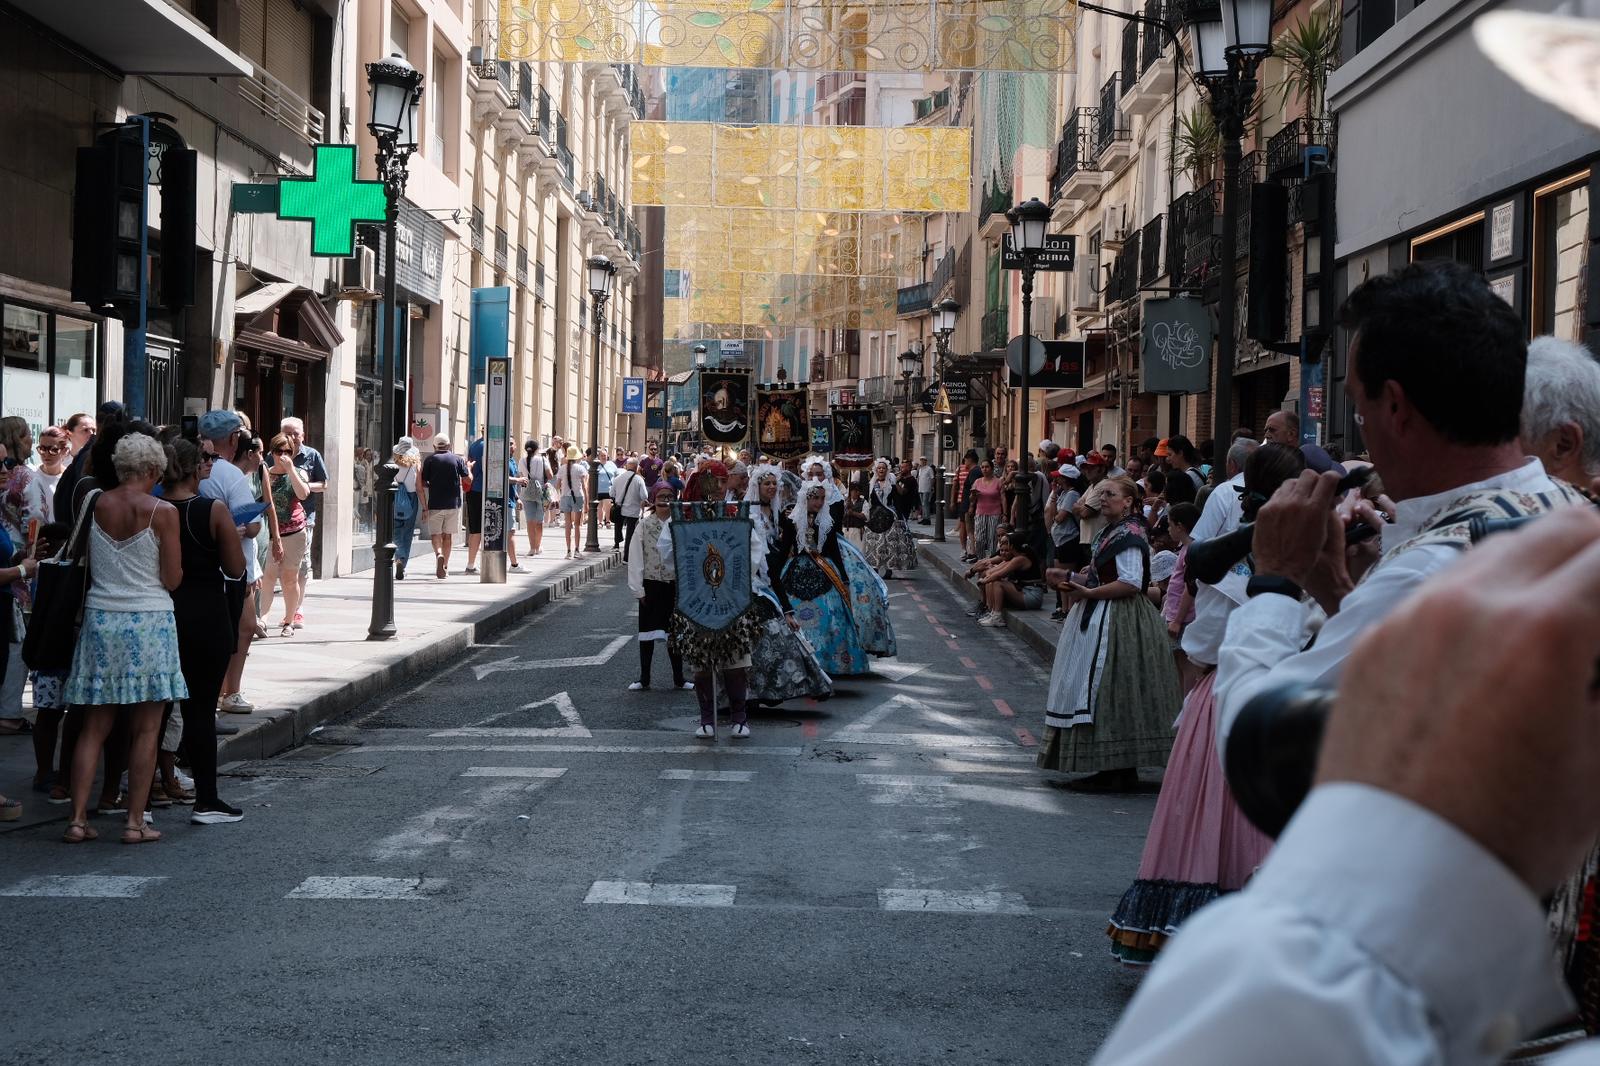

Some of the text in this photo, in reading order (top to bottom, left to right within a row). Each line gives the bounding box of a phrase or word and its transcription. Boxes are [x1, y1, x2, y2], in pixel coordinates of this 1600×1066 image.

[492, 361, 505, 375] 22
[626, 385, 640, 400] P
[944, 434, 954, 449] B
